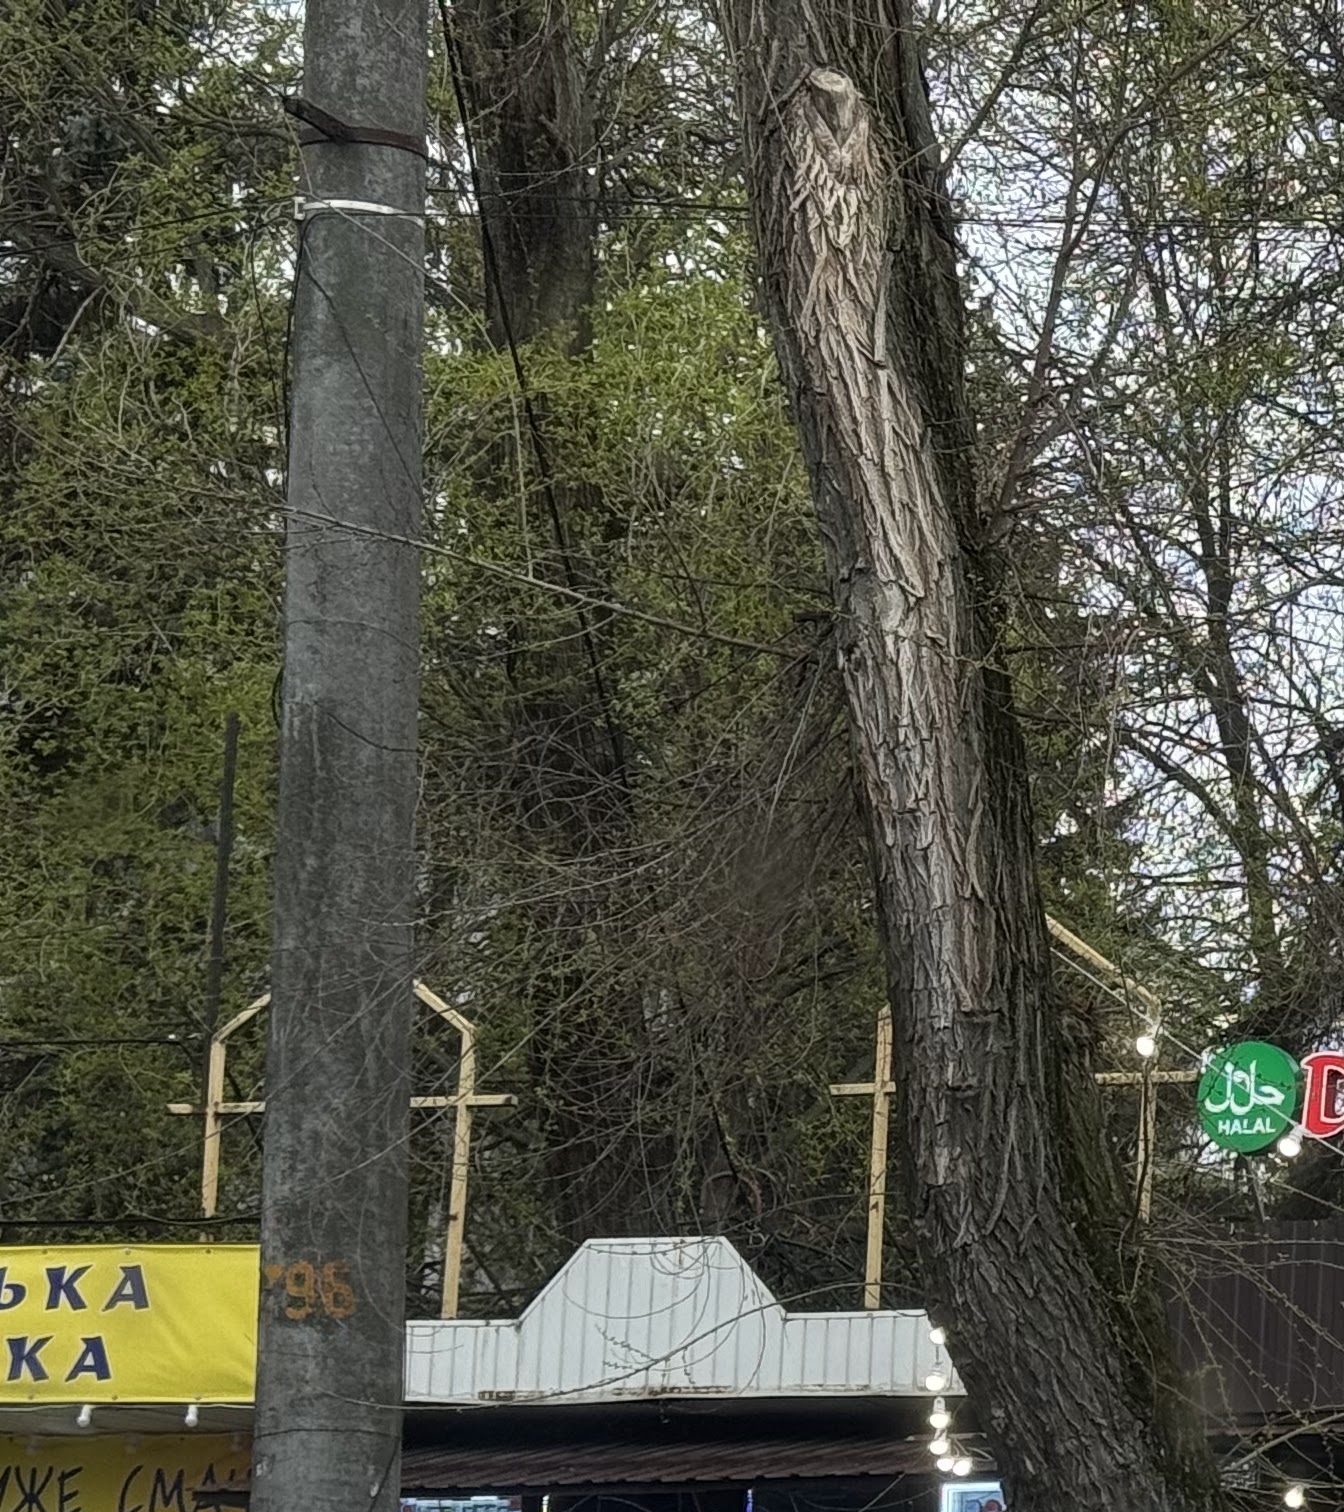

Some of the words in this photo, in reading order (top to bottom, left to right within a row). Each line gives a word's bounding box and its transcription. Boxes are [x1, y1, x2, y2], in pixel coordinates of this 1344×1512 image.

[1204, 1060, 1286, 1116] حلال
[1218, 1117, 1277, 1136] HALAL
[5, 1334, 112, 1383] КА
